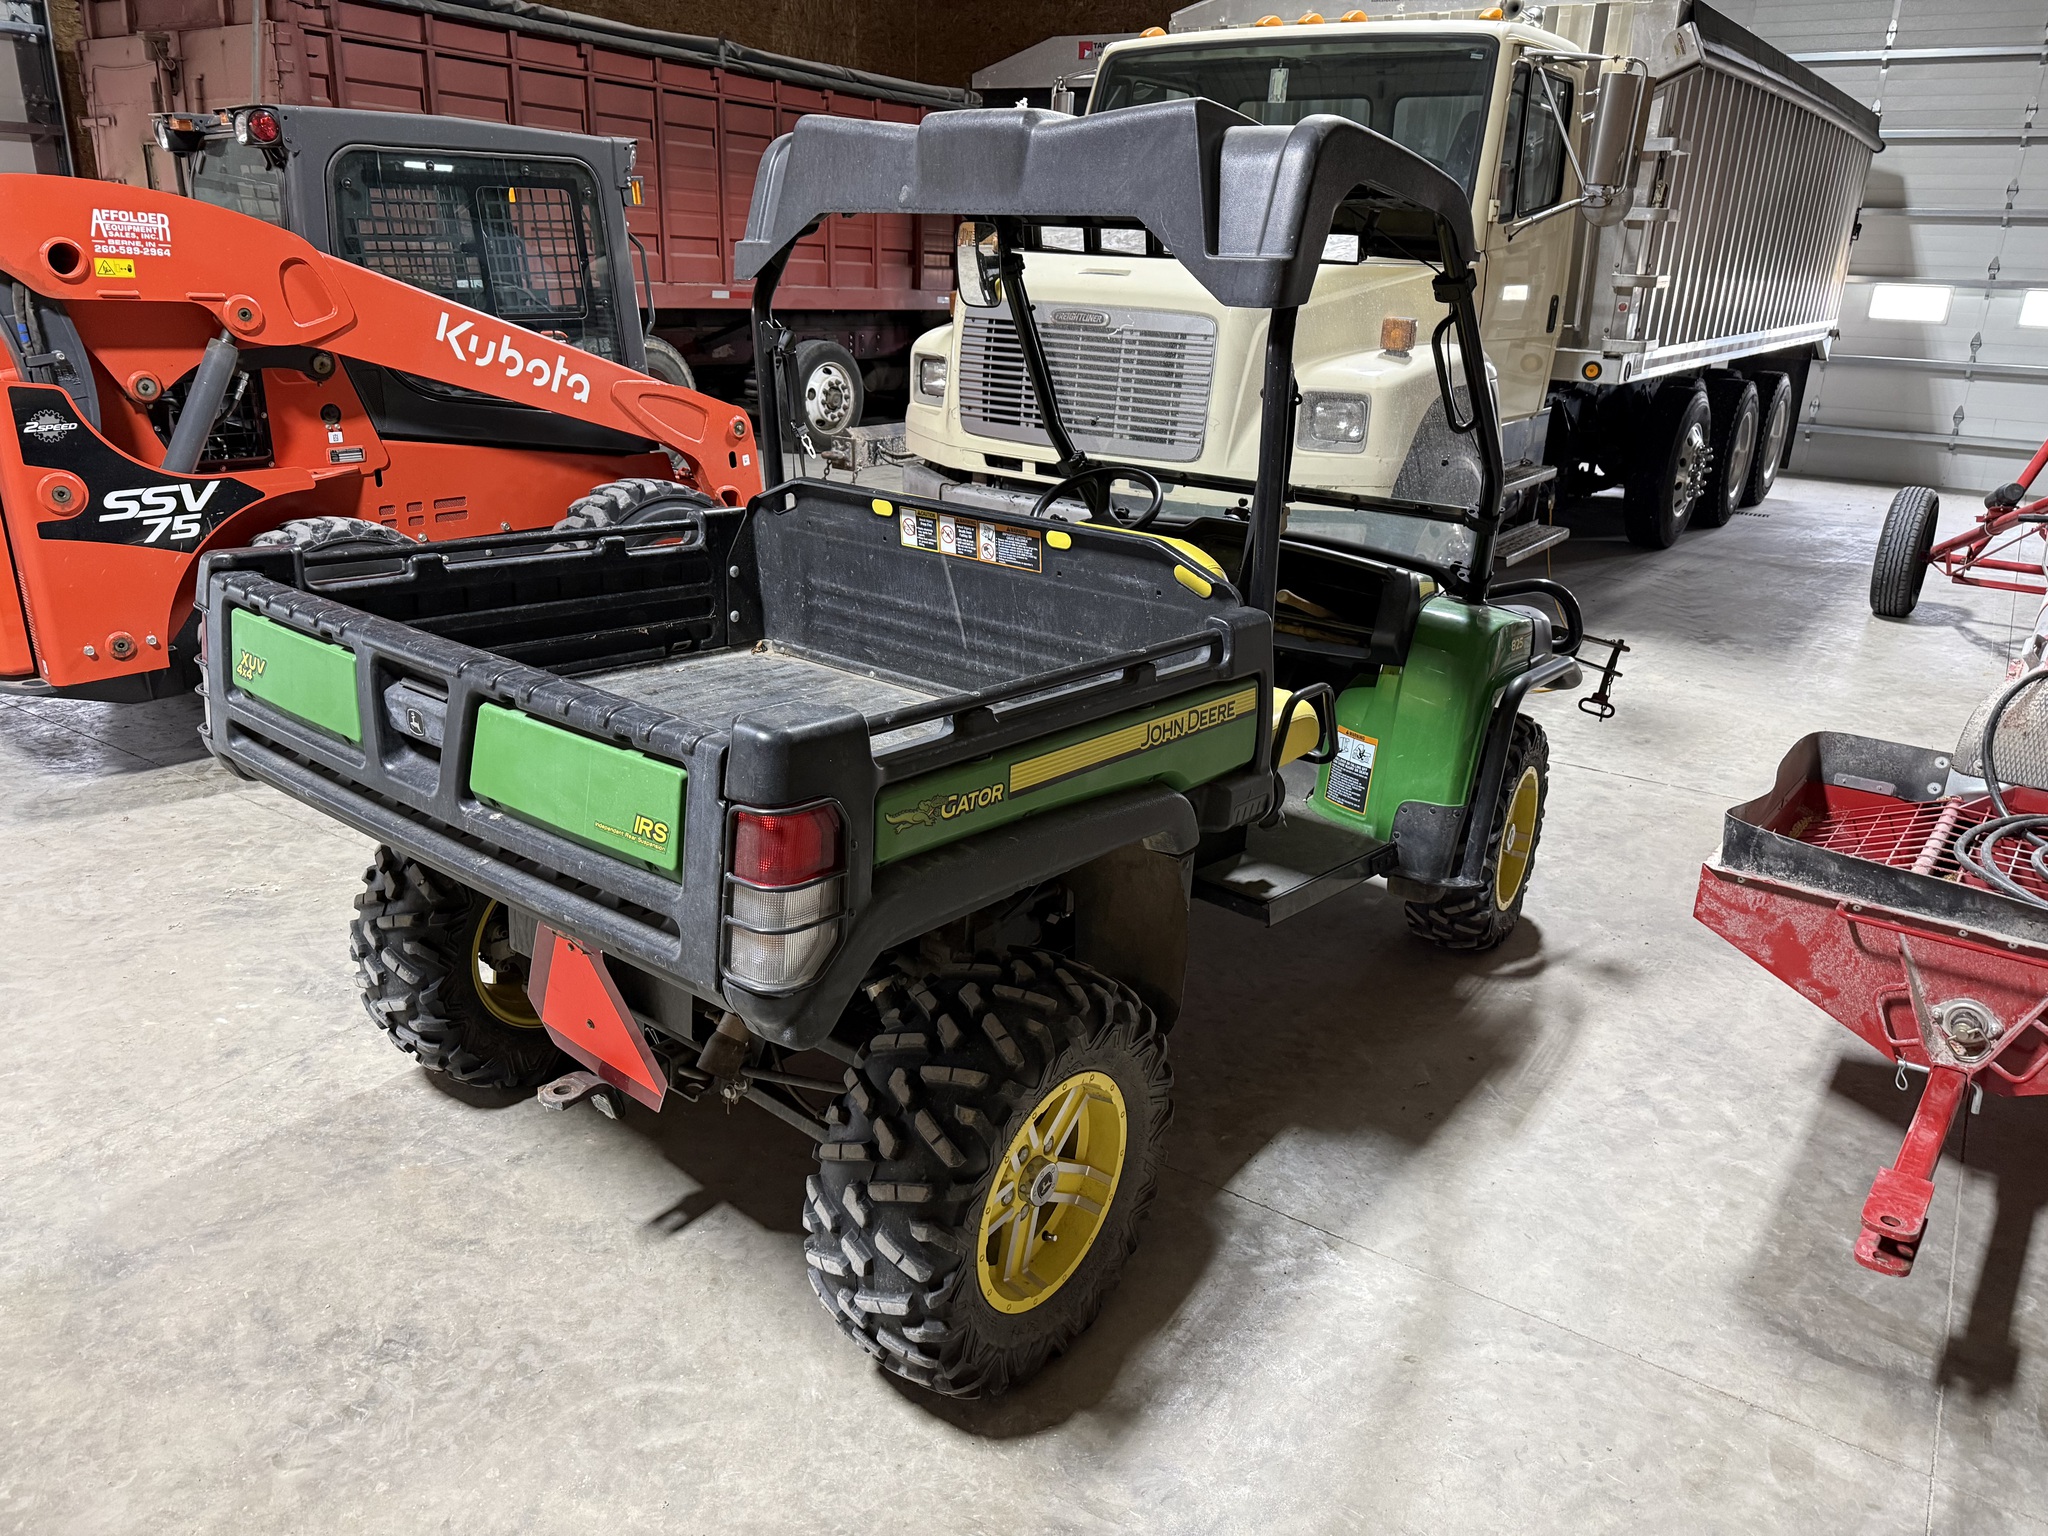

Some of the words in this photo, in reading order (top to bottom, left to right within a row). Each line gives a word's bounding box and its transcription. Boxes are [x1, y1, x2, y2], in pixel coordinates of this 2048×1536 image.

[91, 208, 171, 242] AFFOLDER
[105, 223, 158, 234] EQUIPMENT
[108, 230, 139, 240] SALES,
[141, 232, 159, 241] INC.
[94, 244, 171, 257] 260-589-2964
[107, 238, 143, 248] BERNE,
[145, 240, 157, 248] IN
[1055, 312, 1103, 323] FREIGHTLINER
[436, 311, 591, 404] Kubota
[99, 480, 221, 523] SSV
[143, 513, 202, 543] 75
[1511, 637, 1524, 651] 825
[241, 650, 266, 675] XUV
[1140, 716, 1185, 749] JOHN
[1187, 699, 1237, 732] DEERE
[941, 783, 1004, 819] GATOR
[595, 820, 624, 837] Independent
[625, 831, 637, 841] Rear
[637, 836, 666, 852] Suspension
[633, 814, 668, 844] IRS
